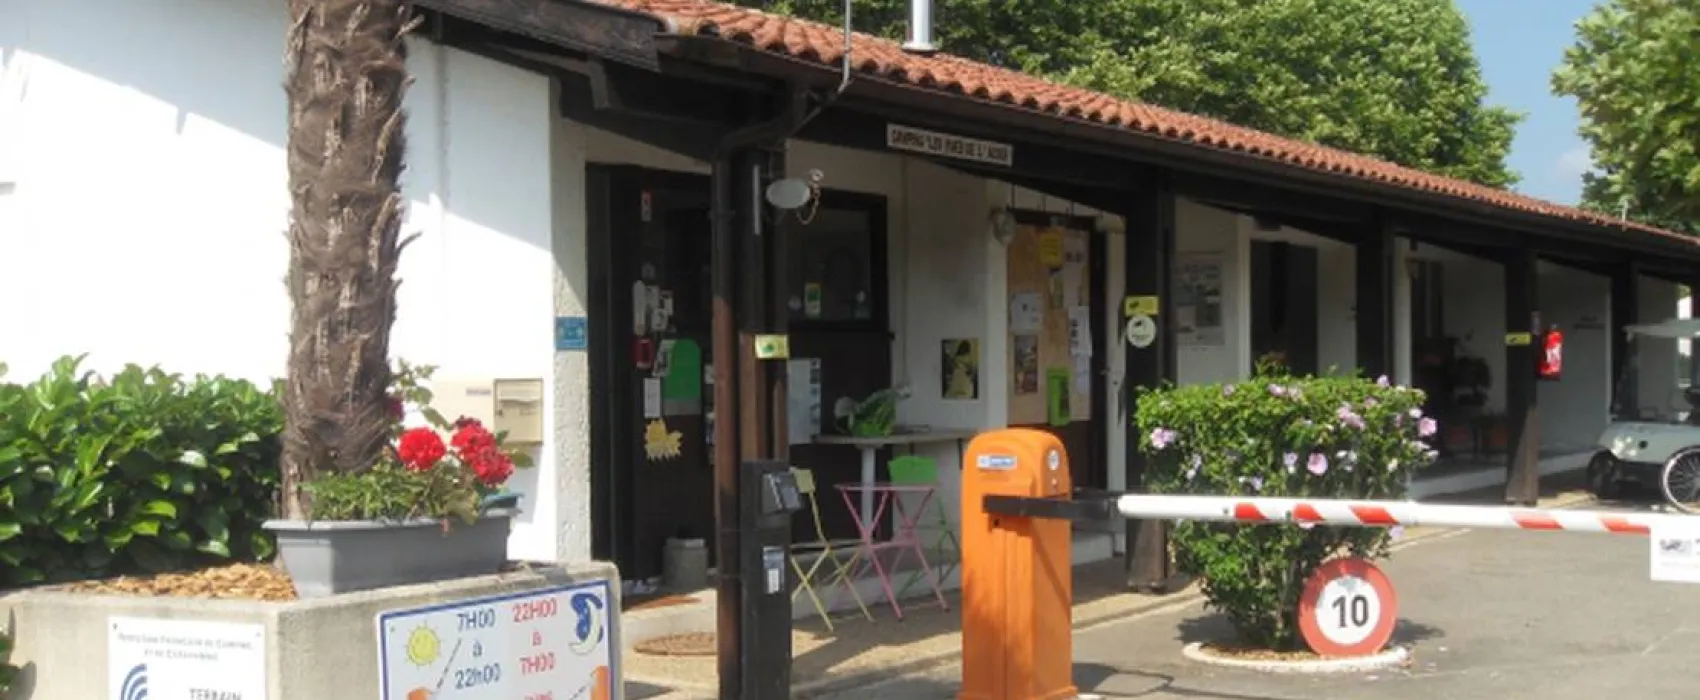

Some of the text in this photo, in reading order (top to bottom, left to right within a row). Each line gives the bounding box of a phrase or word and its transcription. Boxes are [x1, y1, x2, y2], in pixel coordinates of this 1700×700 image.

[457, 608, 496, 632] 7H00
[511, 598, 557, 624] 22H00
[1331, 595, 1369, 628] 10
[519, 653, 556, 675] 7H00
